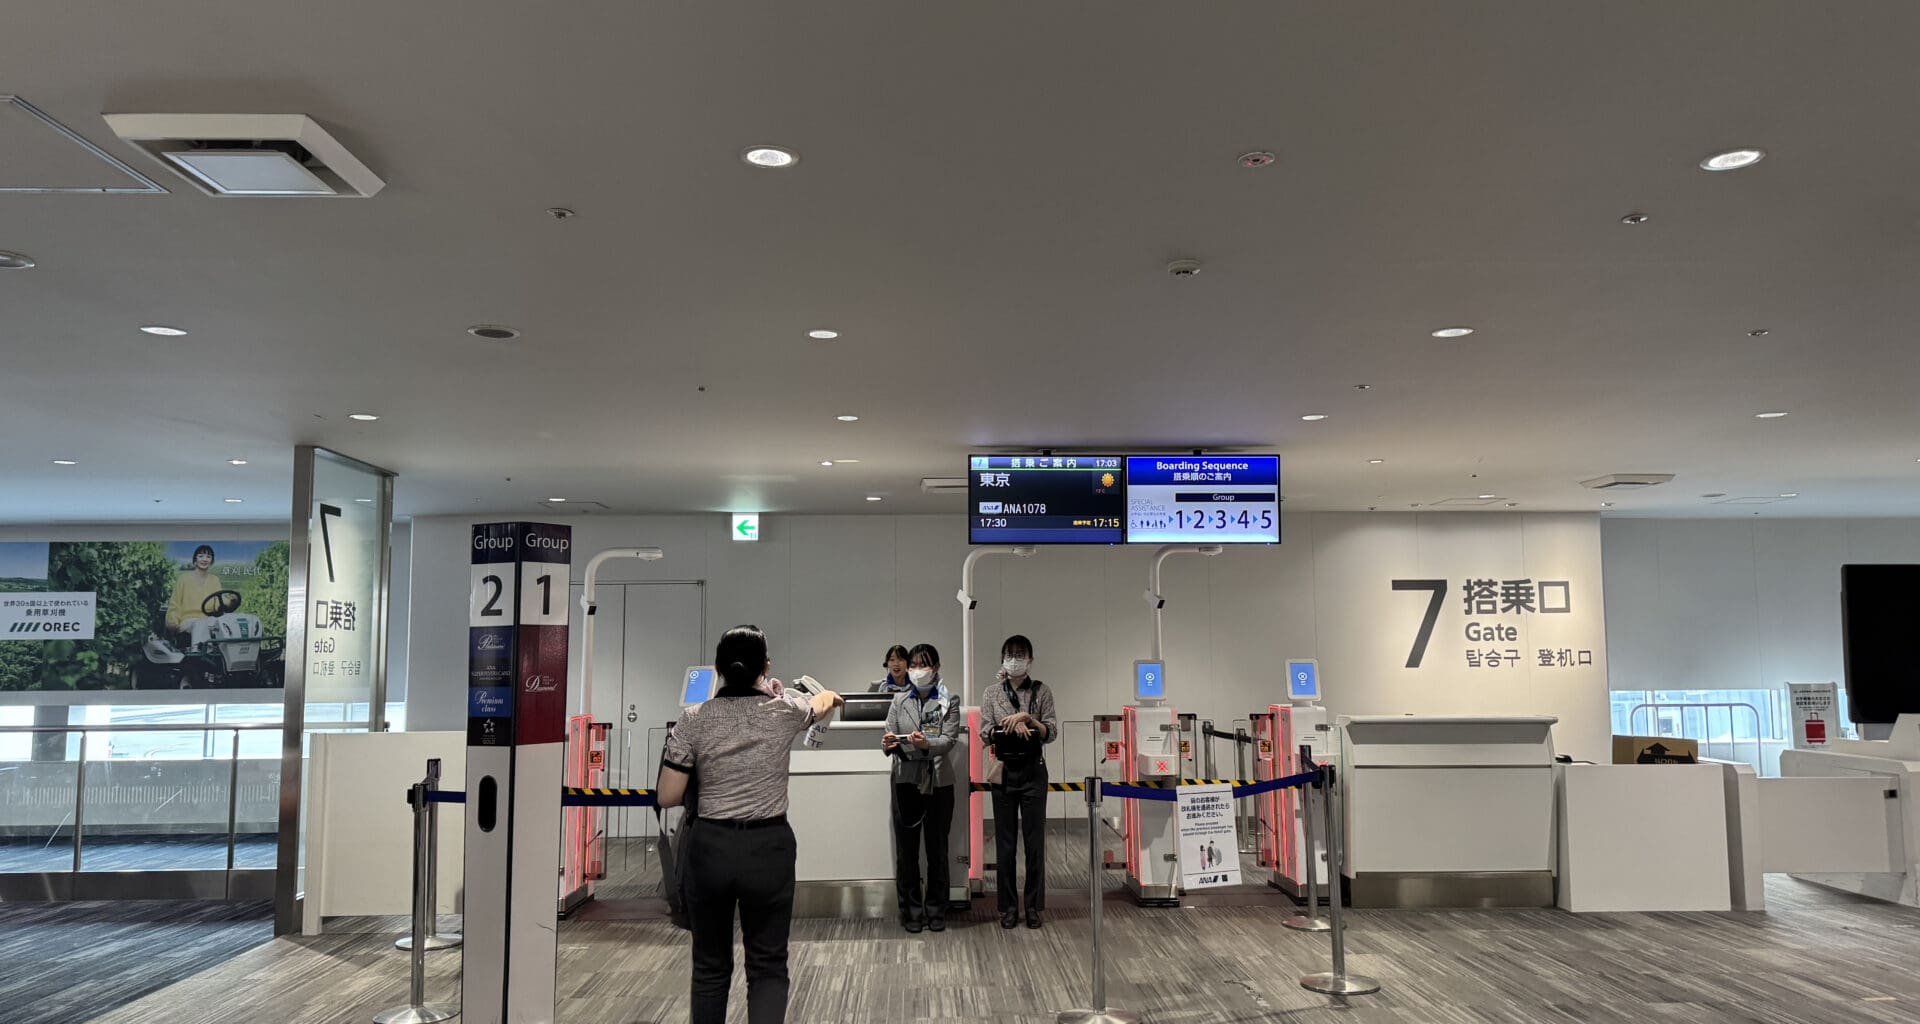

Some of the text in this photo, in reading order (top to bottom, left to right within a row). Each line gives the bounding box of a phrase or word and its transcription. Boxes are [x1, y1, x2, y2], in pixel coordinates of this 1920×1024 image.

[1156, 461, 1249, 472] Boarding Sequence
[979, 472, 1011, 487] 東京
[1212, 494, 1236, 502] Group
[1003, 503, 1047, 514] ANA1078
[980, 518, 1007, 527] 17:30
[1093, 518, 1120, 527] 17:15
[1175, 510, 1272, 529] 1 2 3 4 5
[474, 535, 514, 552] Group
[525, 533, 569, 552] Group
[481, 575, 502, 616] 2
[536, 574, 551, 615] 1
[1463, 578, 1571, 615] 搭乗口
[25, 608, 66, 616] 乗用草刈機
[42, 622, 80, 632] OREC
[1392, 579, 1448, 668] 7
[1465, 622, 1518, 642] Gate
[1466, 649, 1521, 668] 탈승구
[1537, 648, 1592, 667] 登机口
[475, 691, 504, 705] Premium
[481, 705, 496, 713] class
[1199, 876, 1212, 884] ANA
